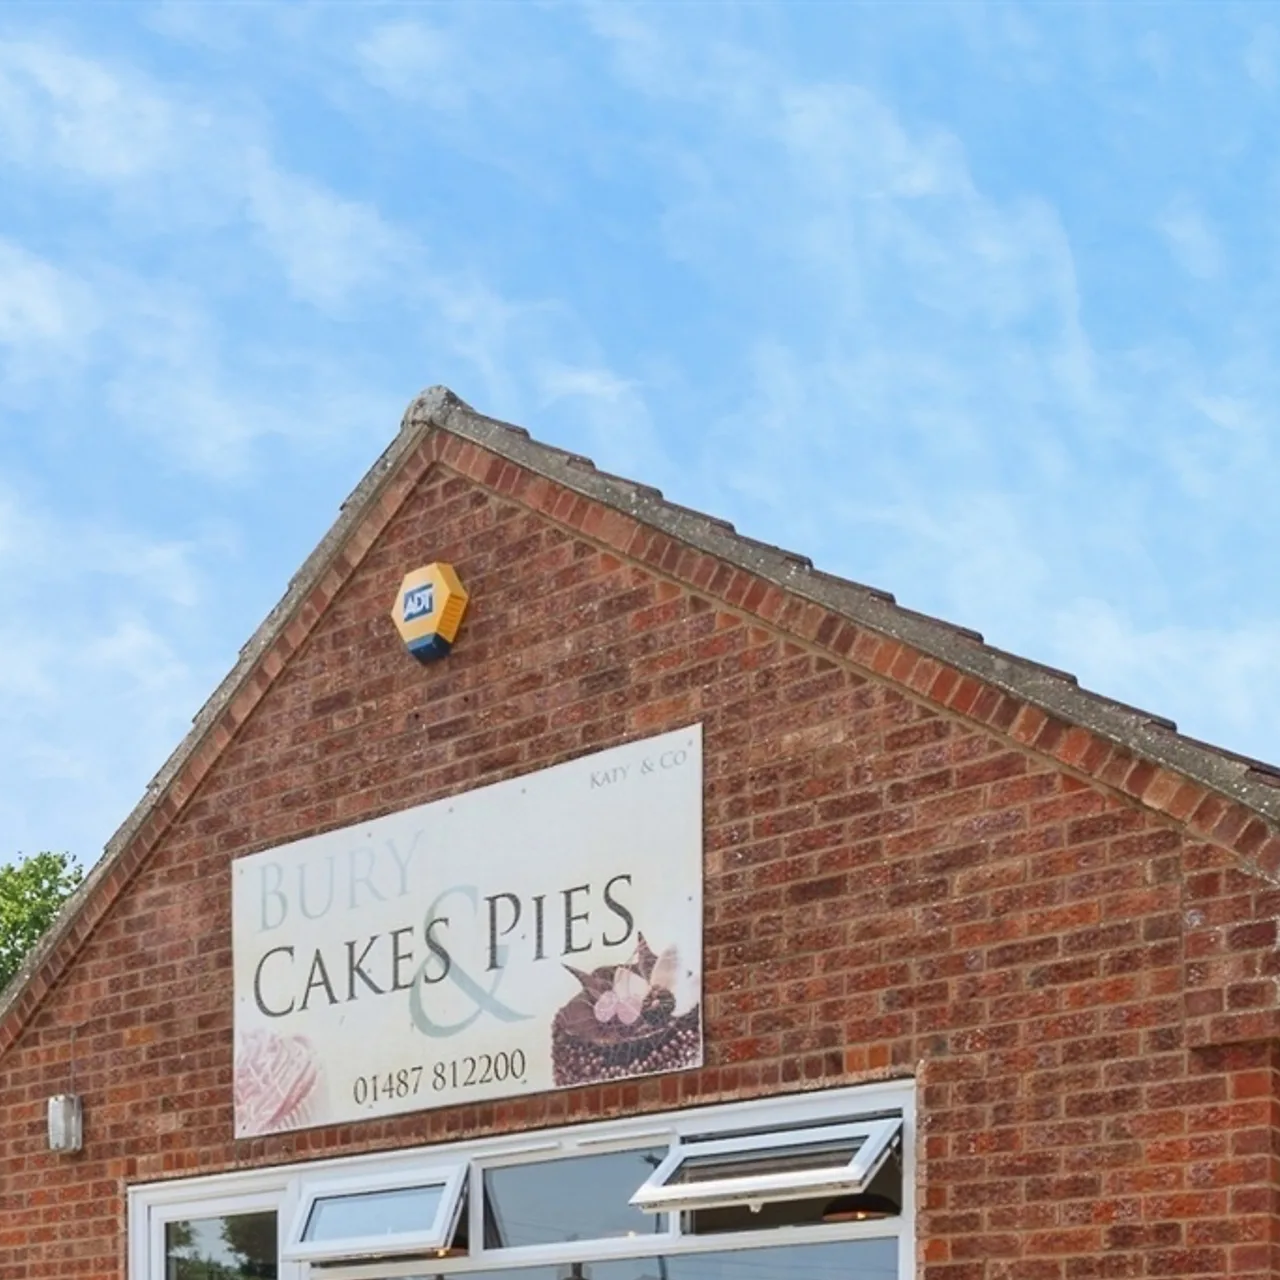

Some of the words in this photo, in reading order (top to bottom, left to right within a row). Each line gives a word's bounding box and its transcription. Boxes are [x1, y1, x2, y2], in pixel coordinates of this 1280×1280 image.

[405, 588, 432, 617] ADT
[590, 764, 631, 789] KATY
[640, 756, 655, 775] &
[659, 750, 687, 769] CO
[257, 830, 424, 933] BURY
[253, 917, 451, 1017] CAKES
[410, 884, 536, 1038] &
[484, 874, 634, 971] PIES
[353, 1066, 423, 1105] 01487
[431, 1048, 526, 1091] 812200
